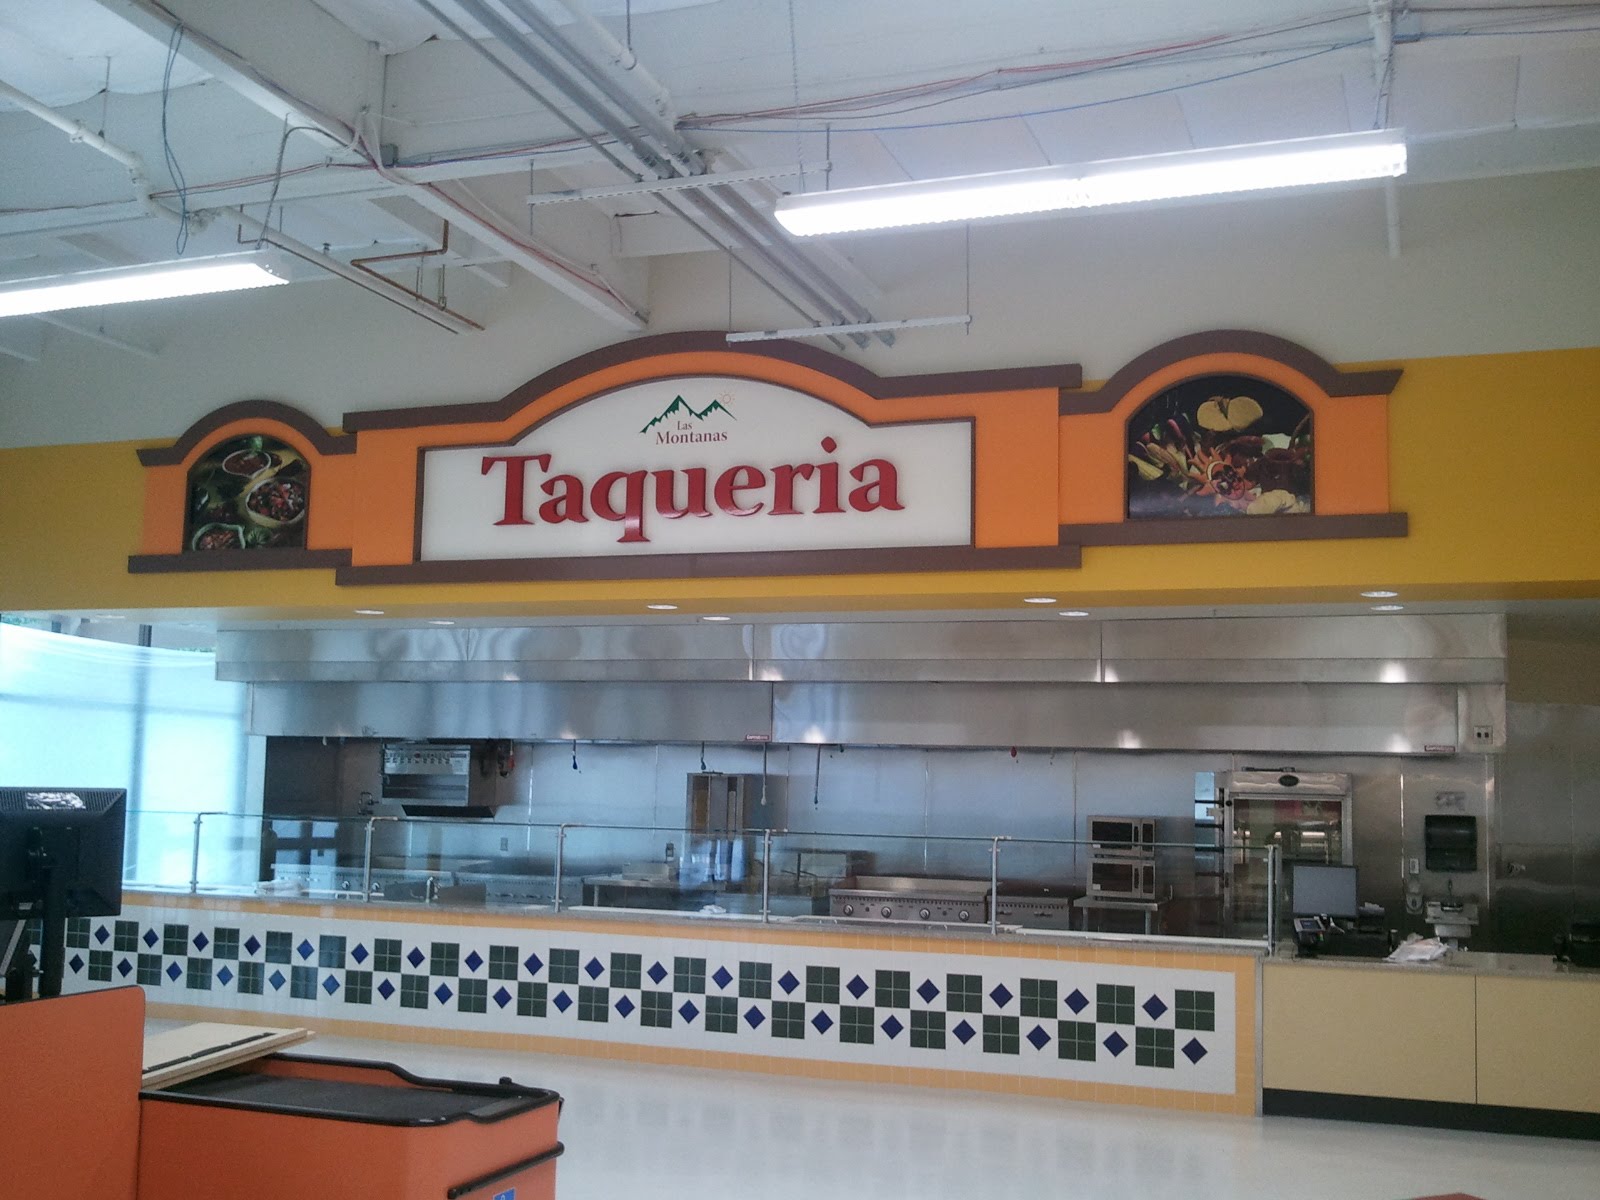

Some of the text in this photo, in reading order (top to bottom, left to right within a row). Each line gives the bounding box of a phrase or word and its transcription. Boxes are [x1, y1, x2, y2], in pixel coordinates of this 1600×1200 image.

[677, 420, 693, 431] Las
[655, 431, 728, 445] Montanas
[481, 436, 906, 543] Taqueria
